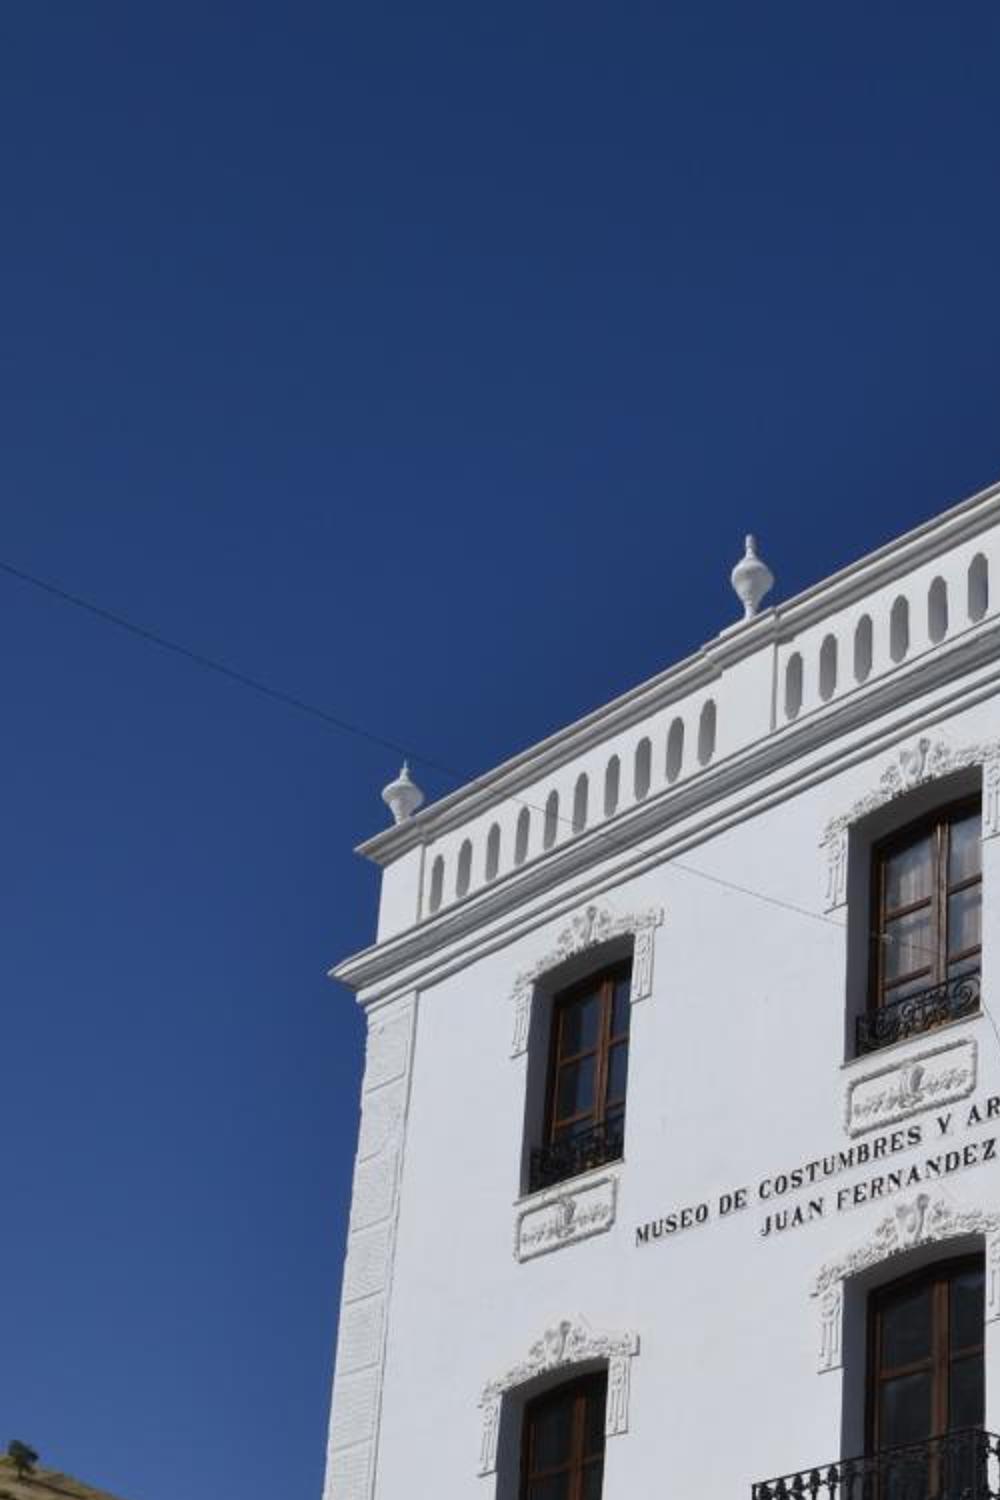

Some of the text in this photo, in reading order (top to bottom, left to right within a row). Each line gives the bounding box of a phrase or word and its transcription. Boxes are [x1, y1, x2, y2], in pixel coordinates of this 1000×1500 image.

[634, 1203, 709, 1247] MUSEO
[718, 1188, 748, 1216] DE
[758, 1125, 924, 1201] COSTUMBRES
[936, 1112, 952, 1136] Y
[761, 1197, 825, 1237] JUAN
[836, 1137, 997, 1212] FERNANDEZ
